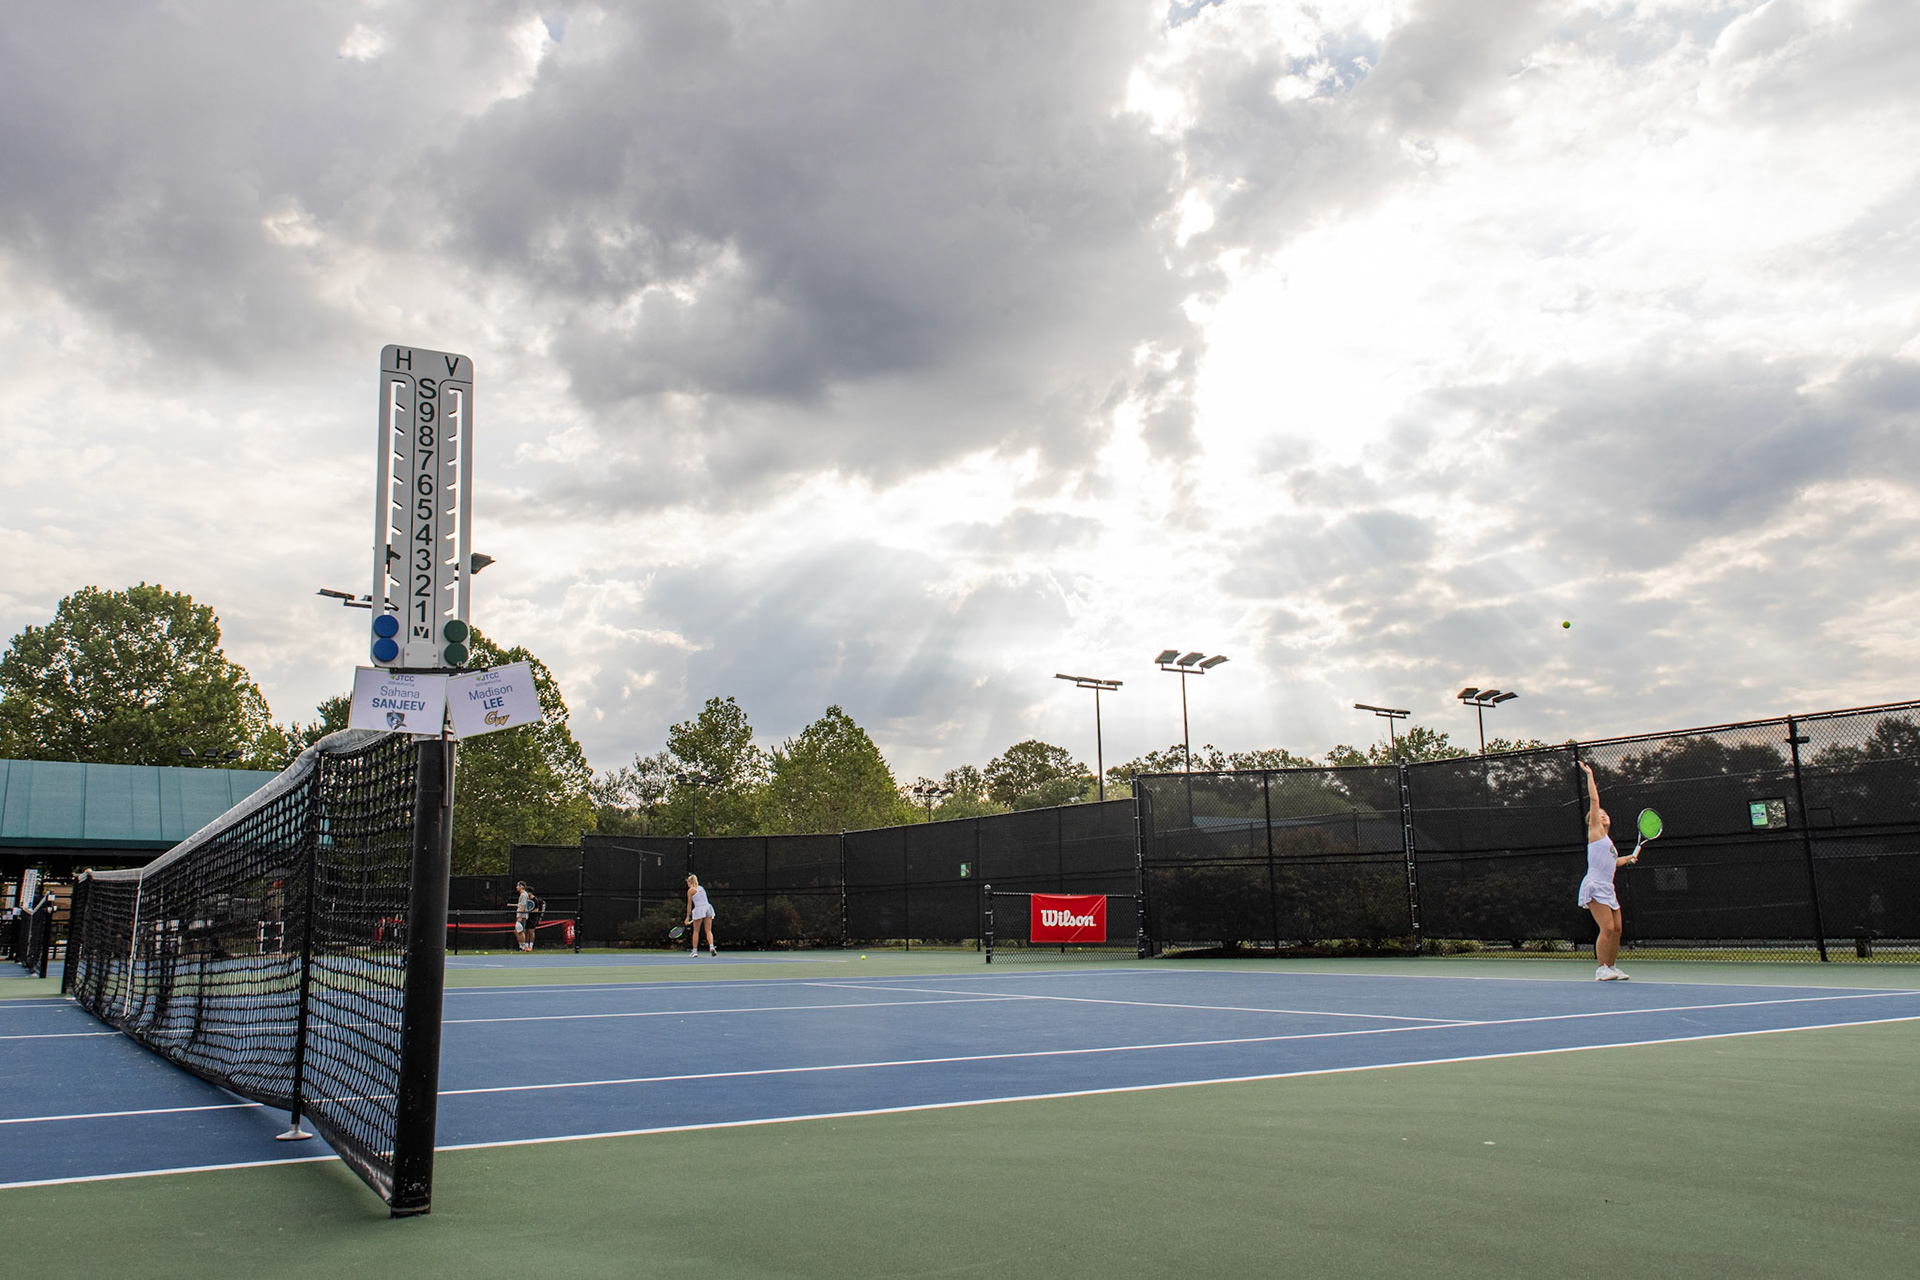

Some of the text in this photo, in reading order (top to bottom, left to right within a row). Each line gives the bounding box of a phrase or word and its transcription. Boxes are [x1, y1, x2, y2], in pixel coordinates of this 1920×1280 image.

[396, 348, 459, 377] H V
[418, 378, 437, 399] S
[419, 401, 435, 423] 9
[418, 425, 434, 447] 8
[418, 449, 434, 470] 7
[417, 474, 433, 496] 6
[417, 498, 433, 520] 5
[415, 523, 433, 546] 4
[415, 548, 431, 571] 3
[415, 574, 431, 597] 2
[415, 600, 426, 622] 1
[481, 672, 500, 681] JTCC
[380, 685, 420, 699] Sahana
[468, 685, 513, 701] Madison
[483, 696, 505, 710] LEE
[372, 697, 426, 711] SANJEEV
[1041, 909, 1096, 927] Wilson
